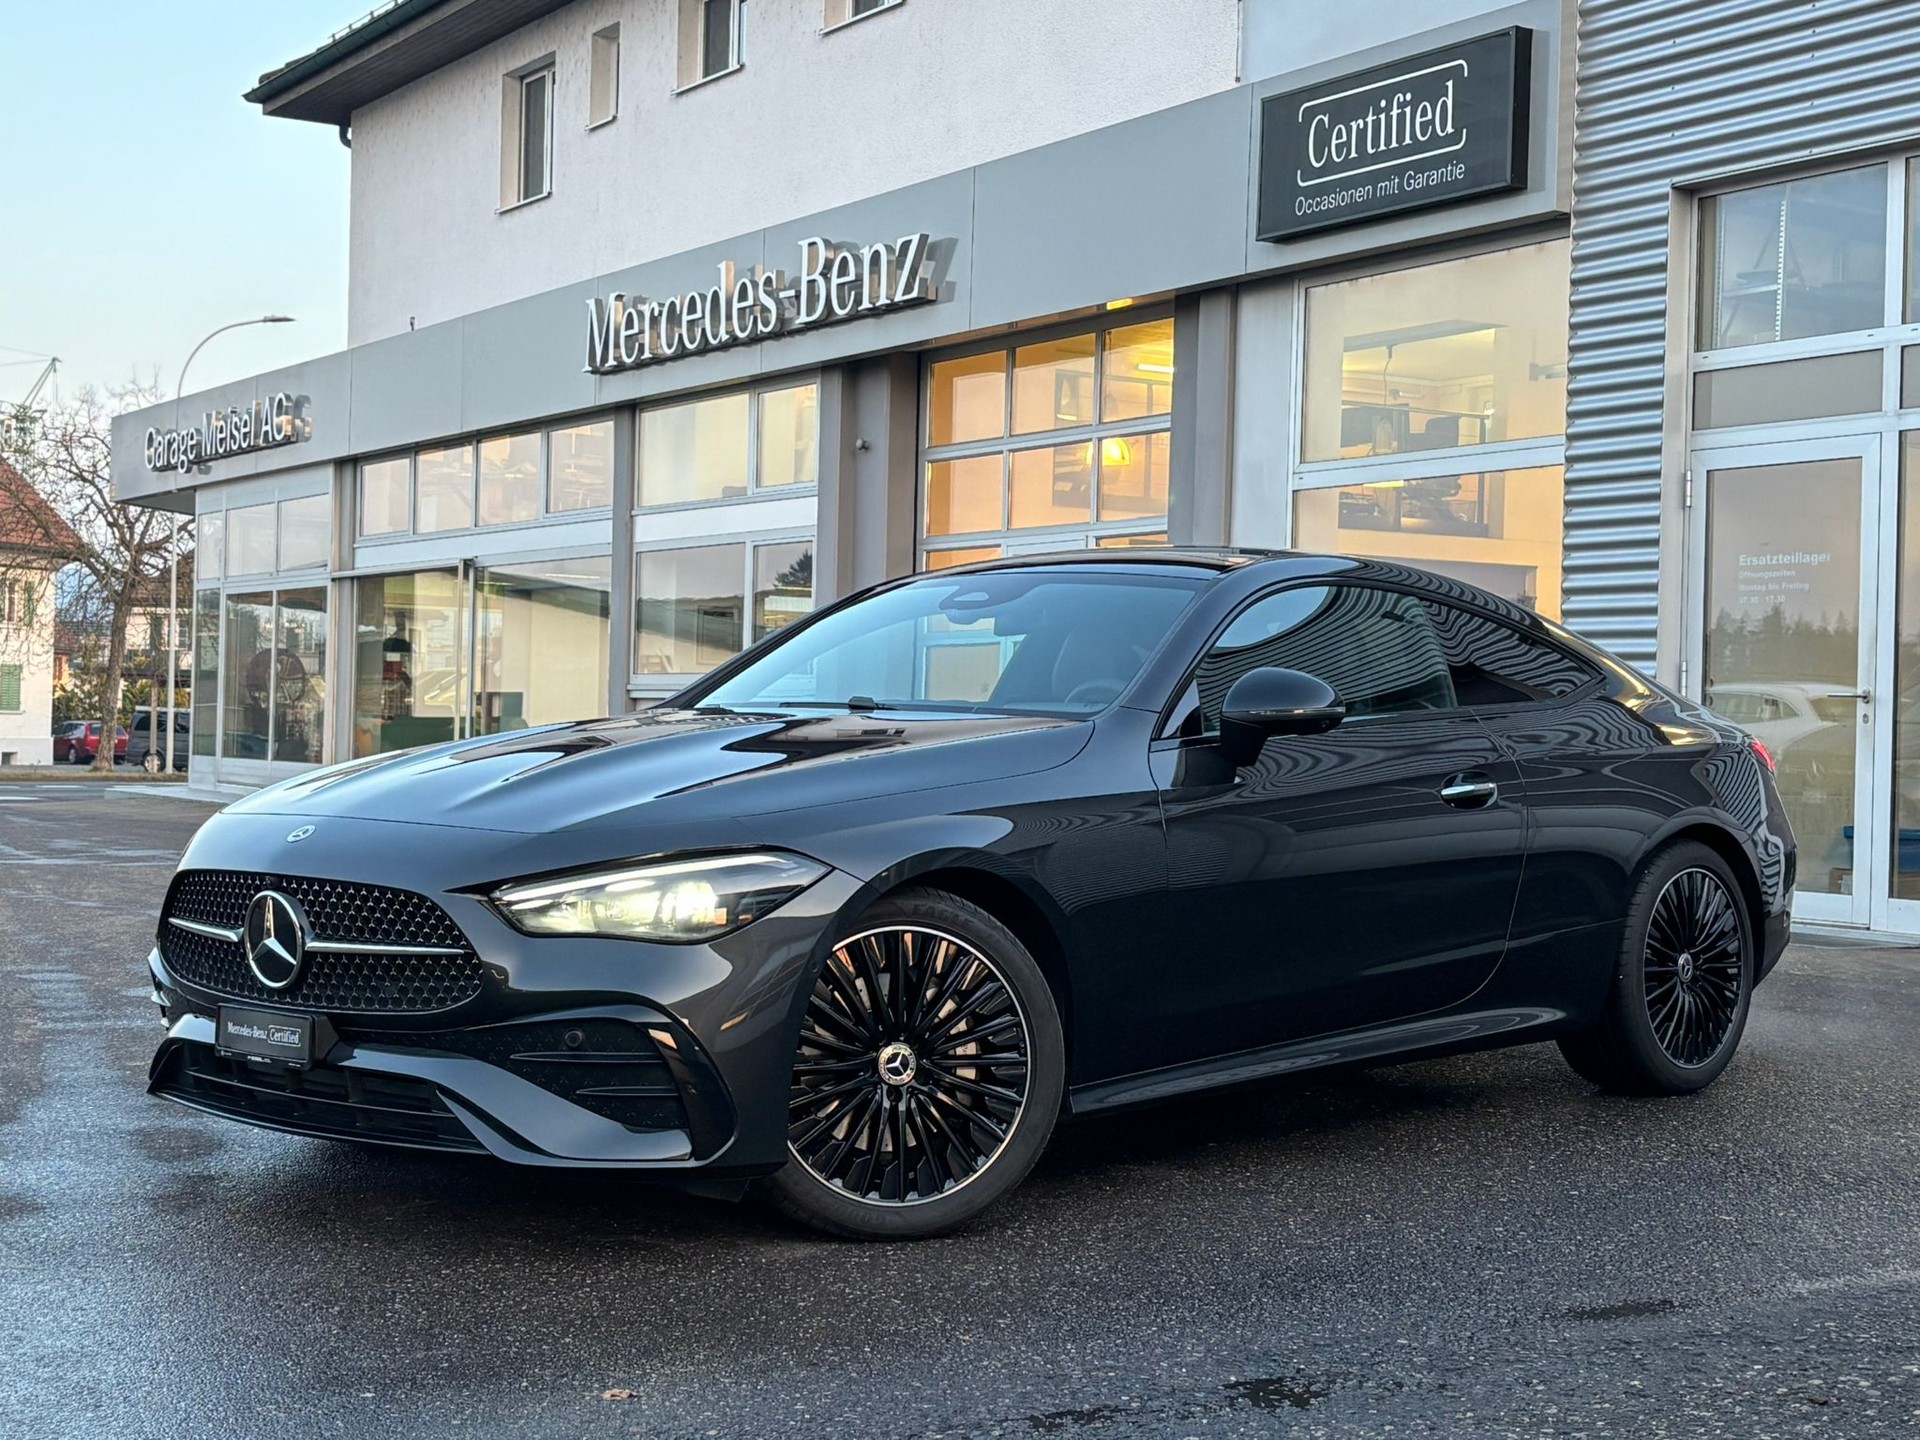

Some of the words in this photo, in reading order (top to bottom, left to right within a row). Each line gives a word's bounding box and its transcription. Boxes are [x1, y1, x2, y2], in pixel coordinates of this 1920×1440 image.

[1308, 79, 1455, 168] Certified
[1295, 184, 1372, 216] Occasionen
[1376, 175, 1399, 198] mit
[1403, 160, 1466, 191] Garantie
[581, 232, 930, 373] Mercedes-Benz
[144, 426, 198, 474] Garage
[201, 405, 256, 457] Meisel
[260, 391, 288, 446] AG
[1739, 551, 1830, 566] Ersatzteillager
[227, 1021, 268, 1040] Mercedes-Benz
[269, 1028, 299, 1044] Certified
